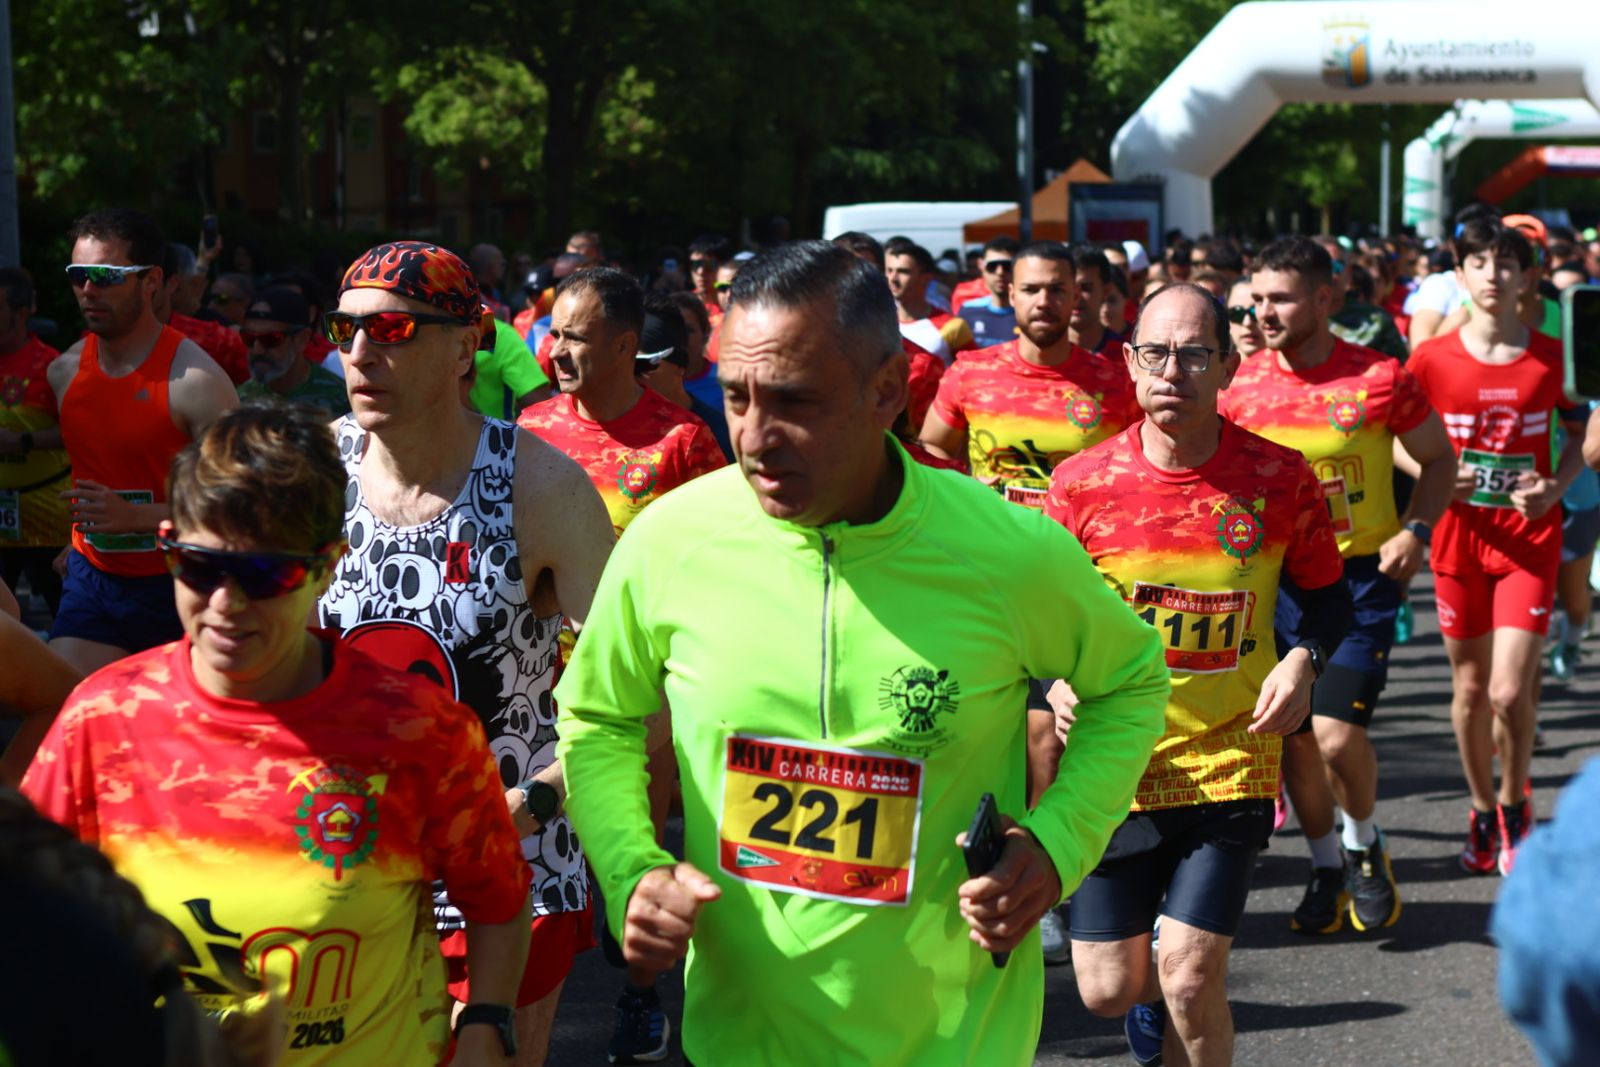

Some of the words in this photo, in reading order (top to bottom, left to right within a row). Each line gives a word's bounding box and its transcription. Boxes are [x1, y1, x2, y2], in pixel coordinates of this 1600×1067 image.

[1384, 38, 1536, 65] Ayuntamiento
[1384, 67, 1410, 85] de
[1417, 65, 1537, 84] Salamanca
[0, 509, 16, 528] 6
[1166, 597, 1218, 612] CARRERA
[731, 739, 776, 772] XIV
[782, 749, 812, 763] SAN
[828, 754, 916, 775] FERNANDO
[779, 761, 867, 788] CARRERA
[1158, 776, 1200, 792] FORTALEZA
[1163, 789, 1198, 804] LEALTAD
[748, 782, 880, 860] 221
[289, 1016, 346, 1050] 2026
